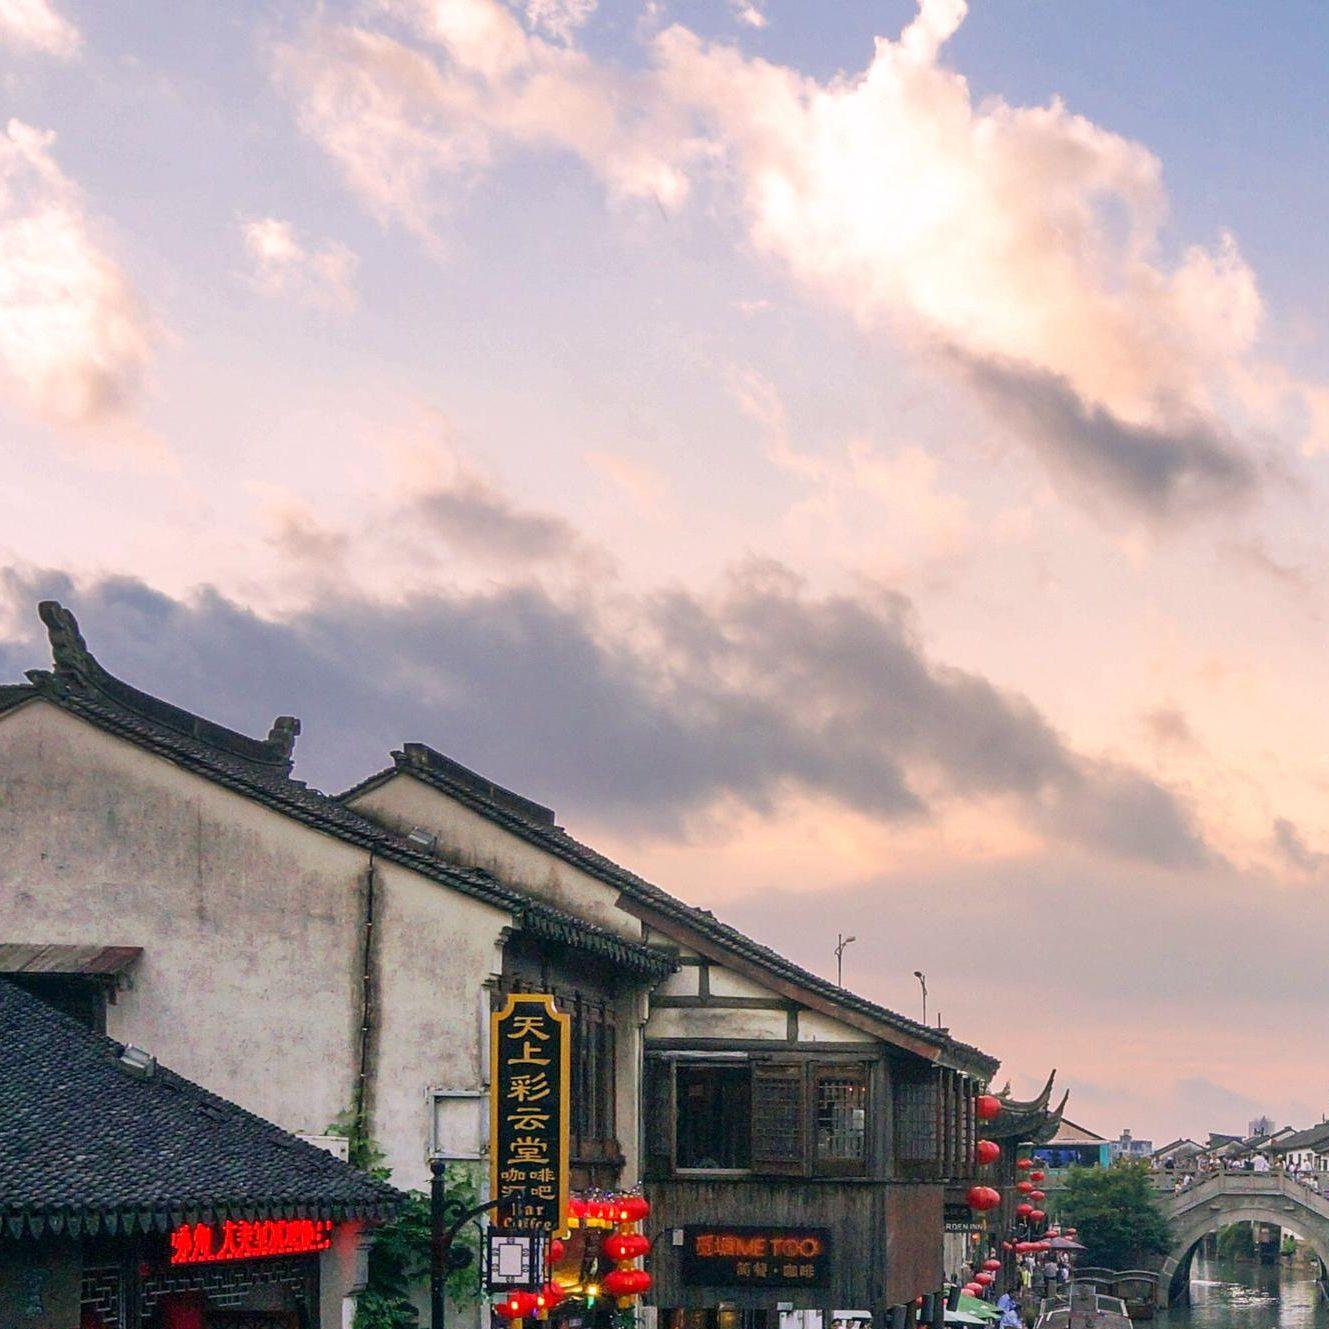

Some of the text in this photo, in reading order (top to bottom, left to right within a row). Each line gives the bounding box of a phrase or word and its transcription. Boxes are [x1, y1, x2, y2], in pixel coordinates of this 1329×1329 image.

[507, 1016, 551, 1164] 天上彩云堂
[501, 1168, 556, 1182] 咖啡
